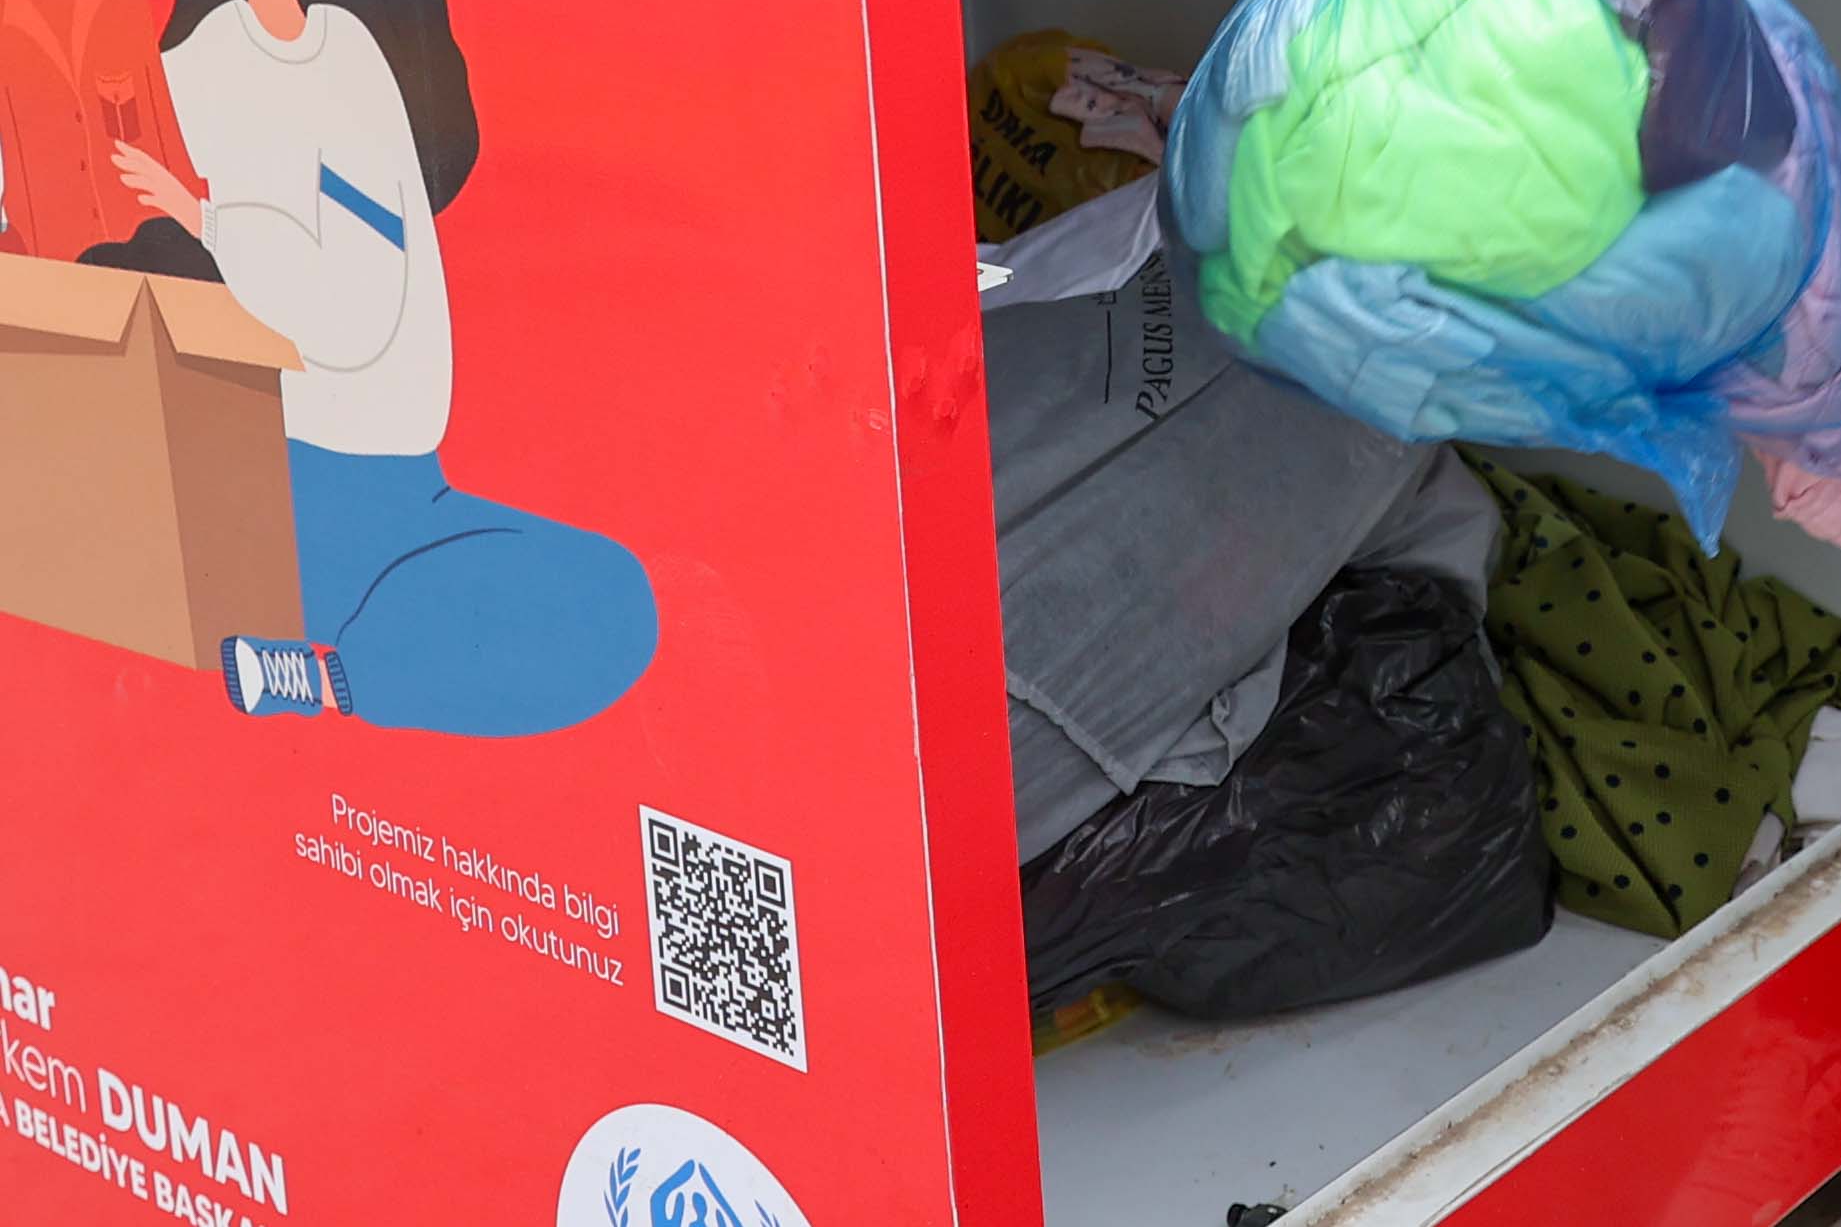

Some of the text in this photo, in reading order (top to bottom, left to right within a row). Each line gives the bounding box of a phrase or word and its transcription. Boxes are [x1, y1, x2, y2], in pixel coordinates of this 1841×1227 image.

[1136, 322, 1174, 421] PAGUS
[295, 832, 624, 986] sahibi olmak için okutunuz
[331, 793, 620, 937] Projemiz hakkında bilgi
[0, 1018, 288, 1216] kem DUMAN
[14, 1098, 149, 1201] BELEDİYE
